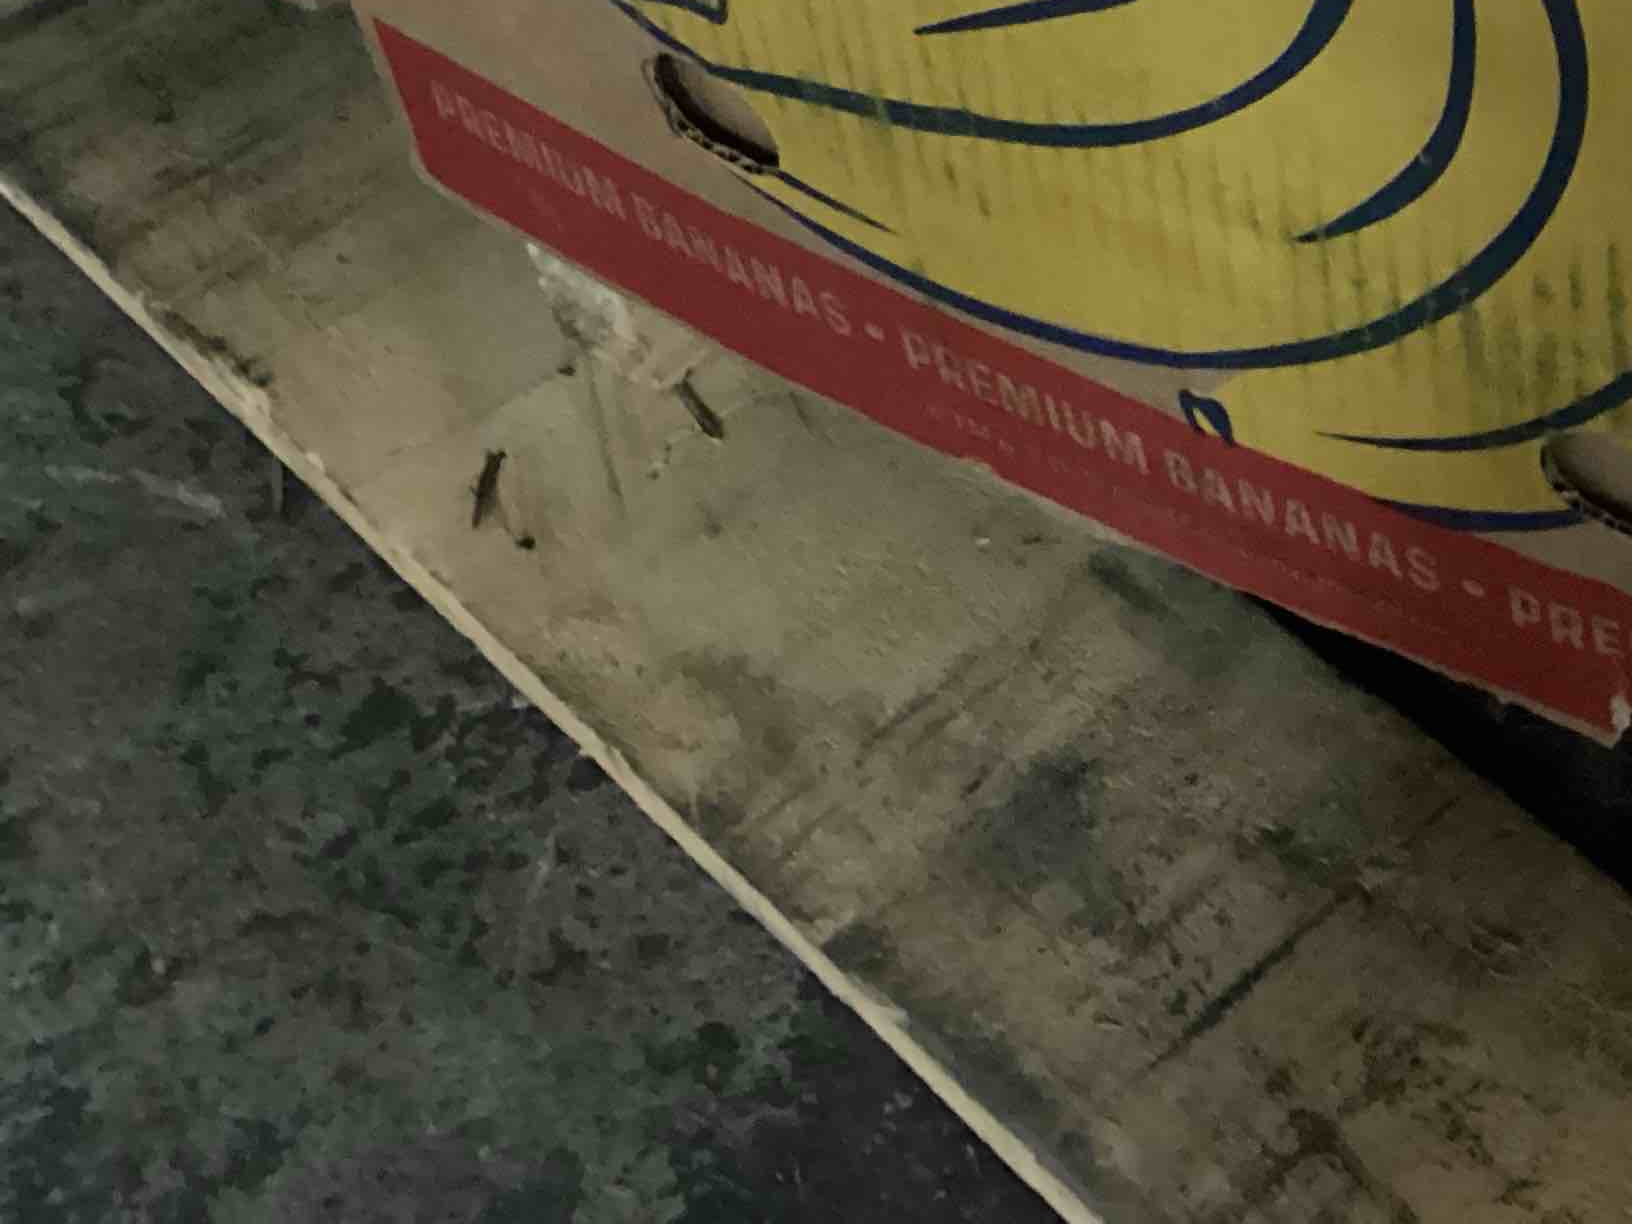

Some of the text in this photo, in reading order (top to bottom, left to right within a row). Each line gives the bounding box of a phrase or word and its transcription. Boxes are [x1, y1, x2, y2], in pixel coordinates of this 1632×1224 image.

[430, 78, 629, 222] PREMIUM
[632, 189, 853, 338] BANANAS
[898, 327, 1153, 476] PREMIUM
[1164, 450, 1442, 594] BANANAS
